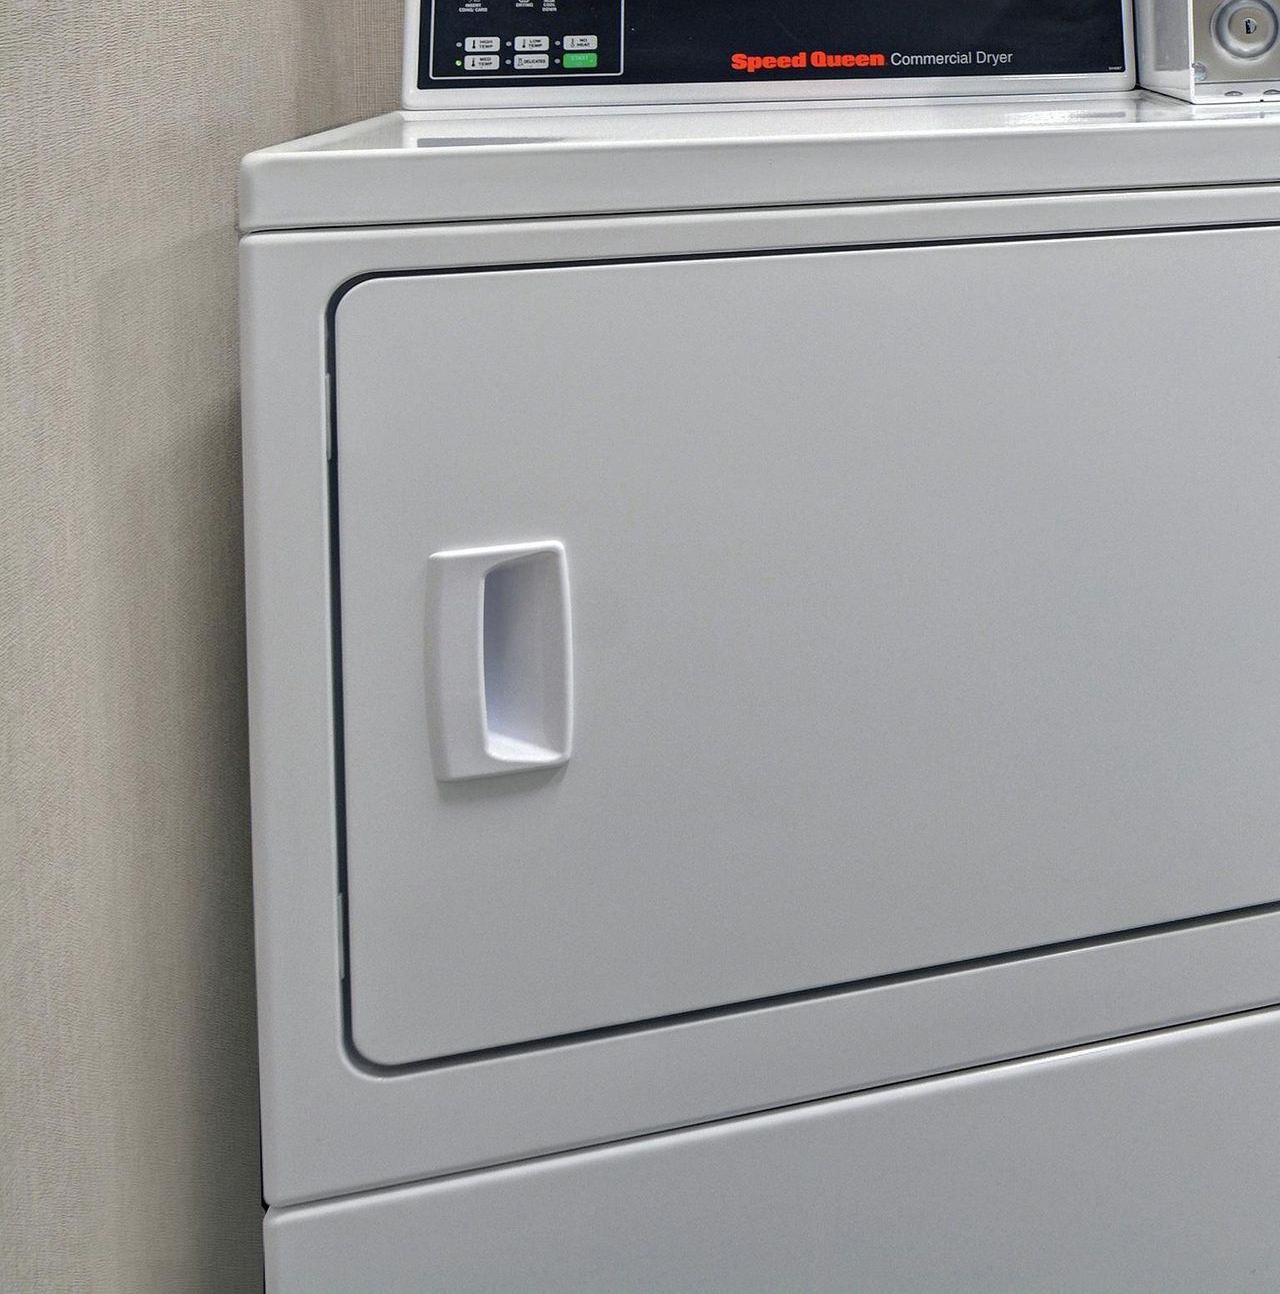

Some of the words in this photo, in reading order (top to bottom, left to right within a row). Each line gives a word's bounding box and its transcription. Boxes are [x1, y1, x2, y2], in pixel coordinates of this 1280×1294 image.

[731, 52, 807, 73] Speed
[810, 50, 885, 68] Queen
[890, 51, 972, 67] Commercial
[976, 50, 1013, 67] Dryer
